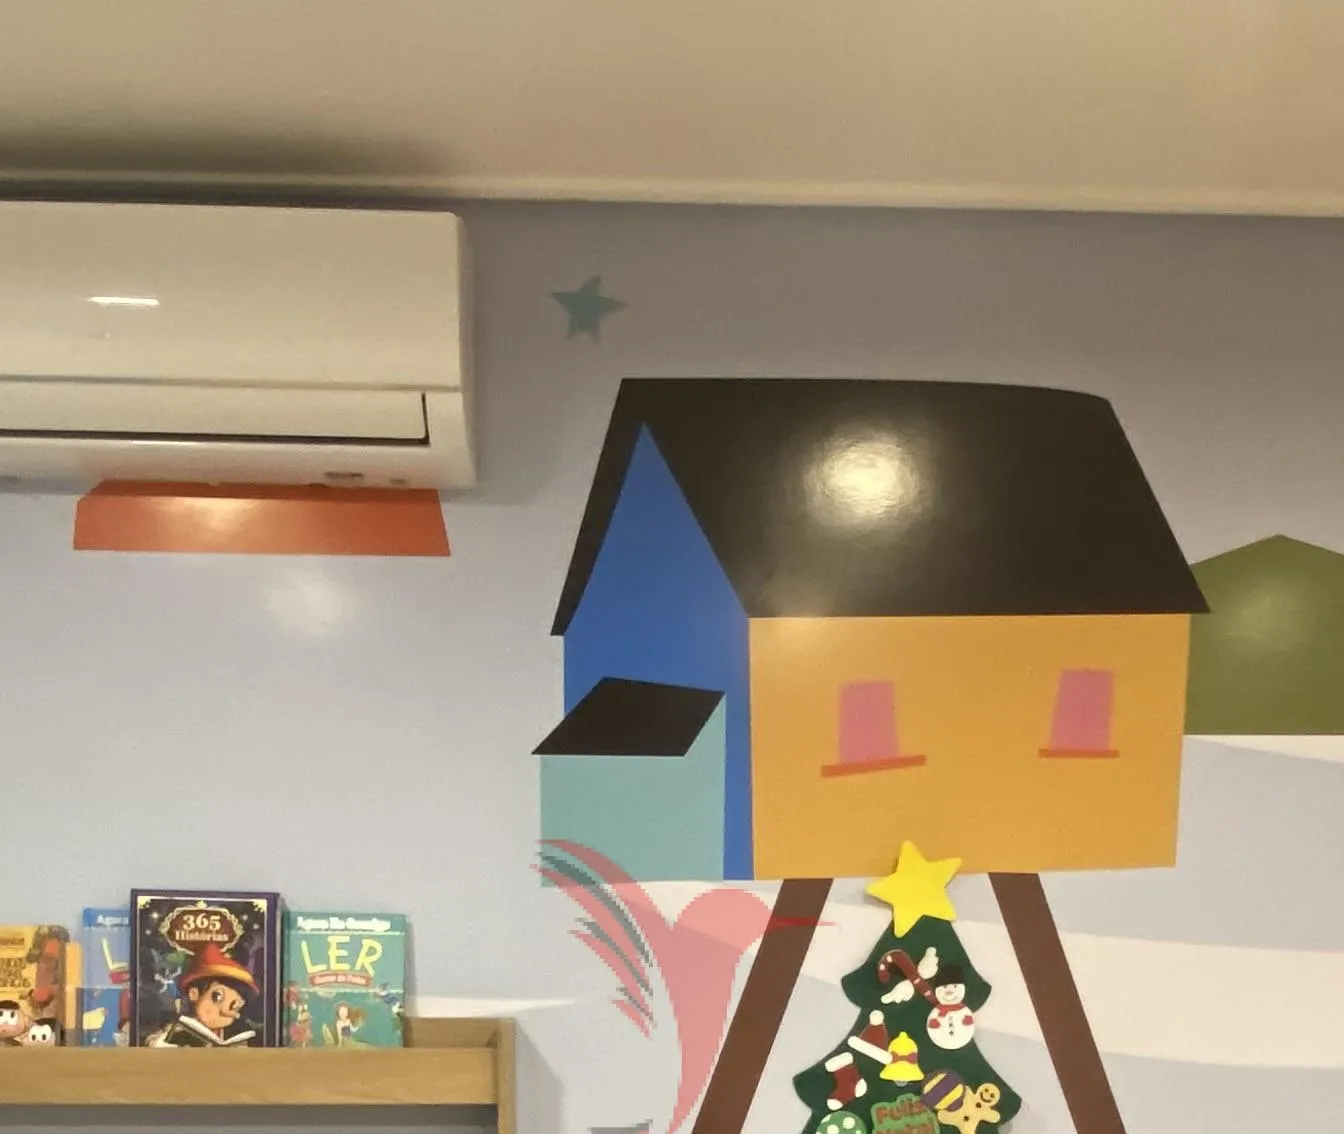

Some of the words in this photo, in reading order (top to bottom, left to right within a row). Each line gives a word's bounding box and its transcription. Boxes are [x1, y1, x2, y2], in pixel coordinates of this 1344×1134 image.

[182, 912, 221, 931] 365
[300, 935, 383, 977] LER
[875, 1096, 927, 1124] Feliz
